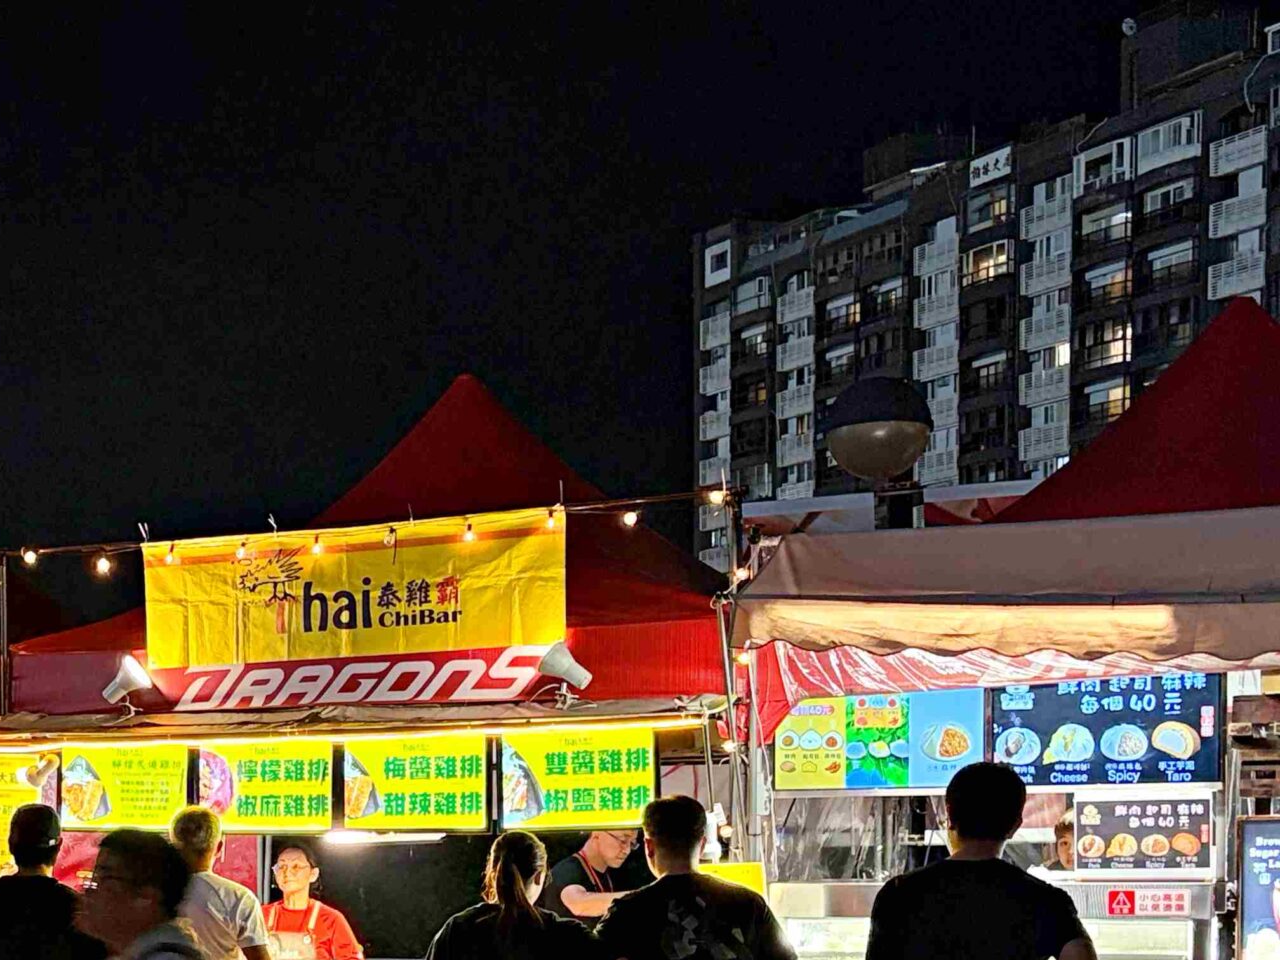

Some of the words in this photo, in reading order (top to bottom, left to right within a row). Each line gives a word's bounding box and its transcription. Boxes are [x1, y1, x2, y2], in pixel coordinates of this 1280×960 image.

[377, 576, 461, 609] 泰雞霸
[378, 608, 462, 628] ChiBar
[174, 645, 553, 711] DRAGONS
[1080, 696, 1123, 714] 每個
[1130, 695, 1156, 711] 40
[237, 759, 328, 783] 檸檬雞排
[384, 755, 482, 780] 梅醬雞排
[544, 747, 650, 775] 雙醬雞排
[1050, 772, 1088, 783] Cheese
[1108, 770, 1140, 784] Spicy
[1165, 771, 1191, 782] Taro
[237, 794, 328, 817] 椒麻雞排
[384, 791, 482, 815] 甜辣雞排
[544, 785, 650, 812] 椒鹽雞排
[1158, 816, 1174, 827] 40
